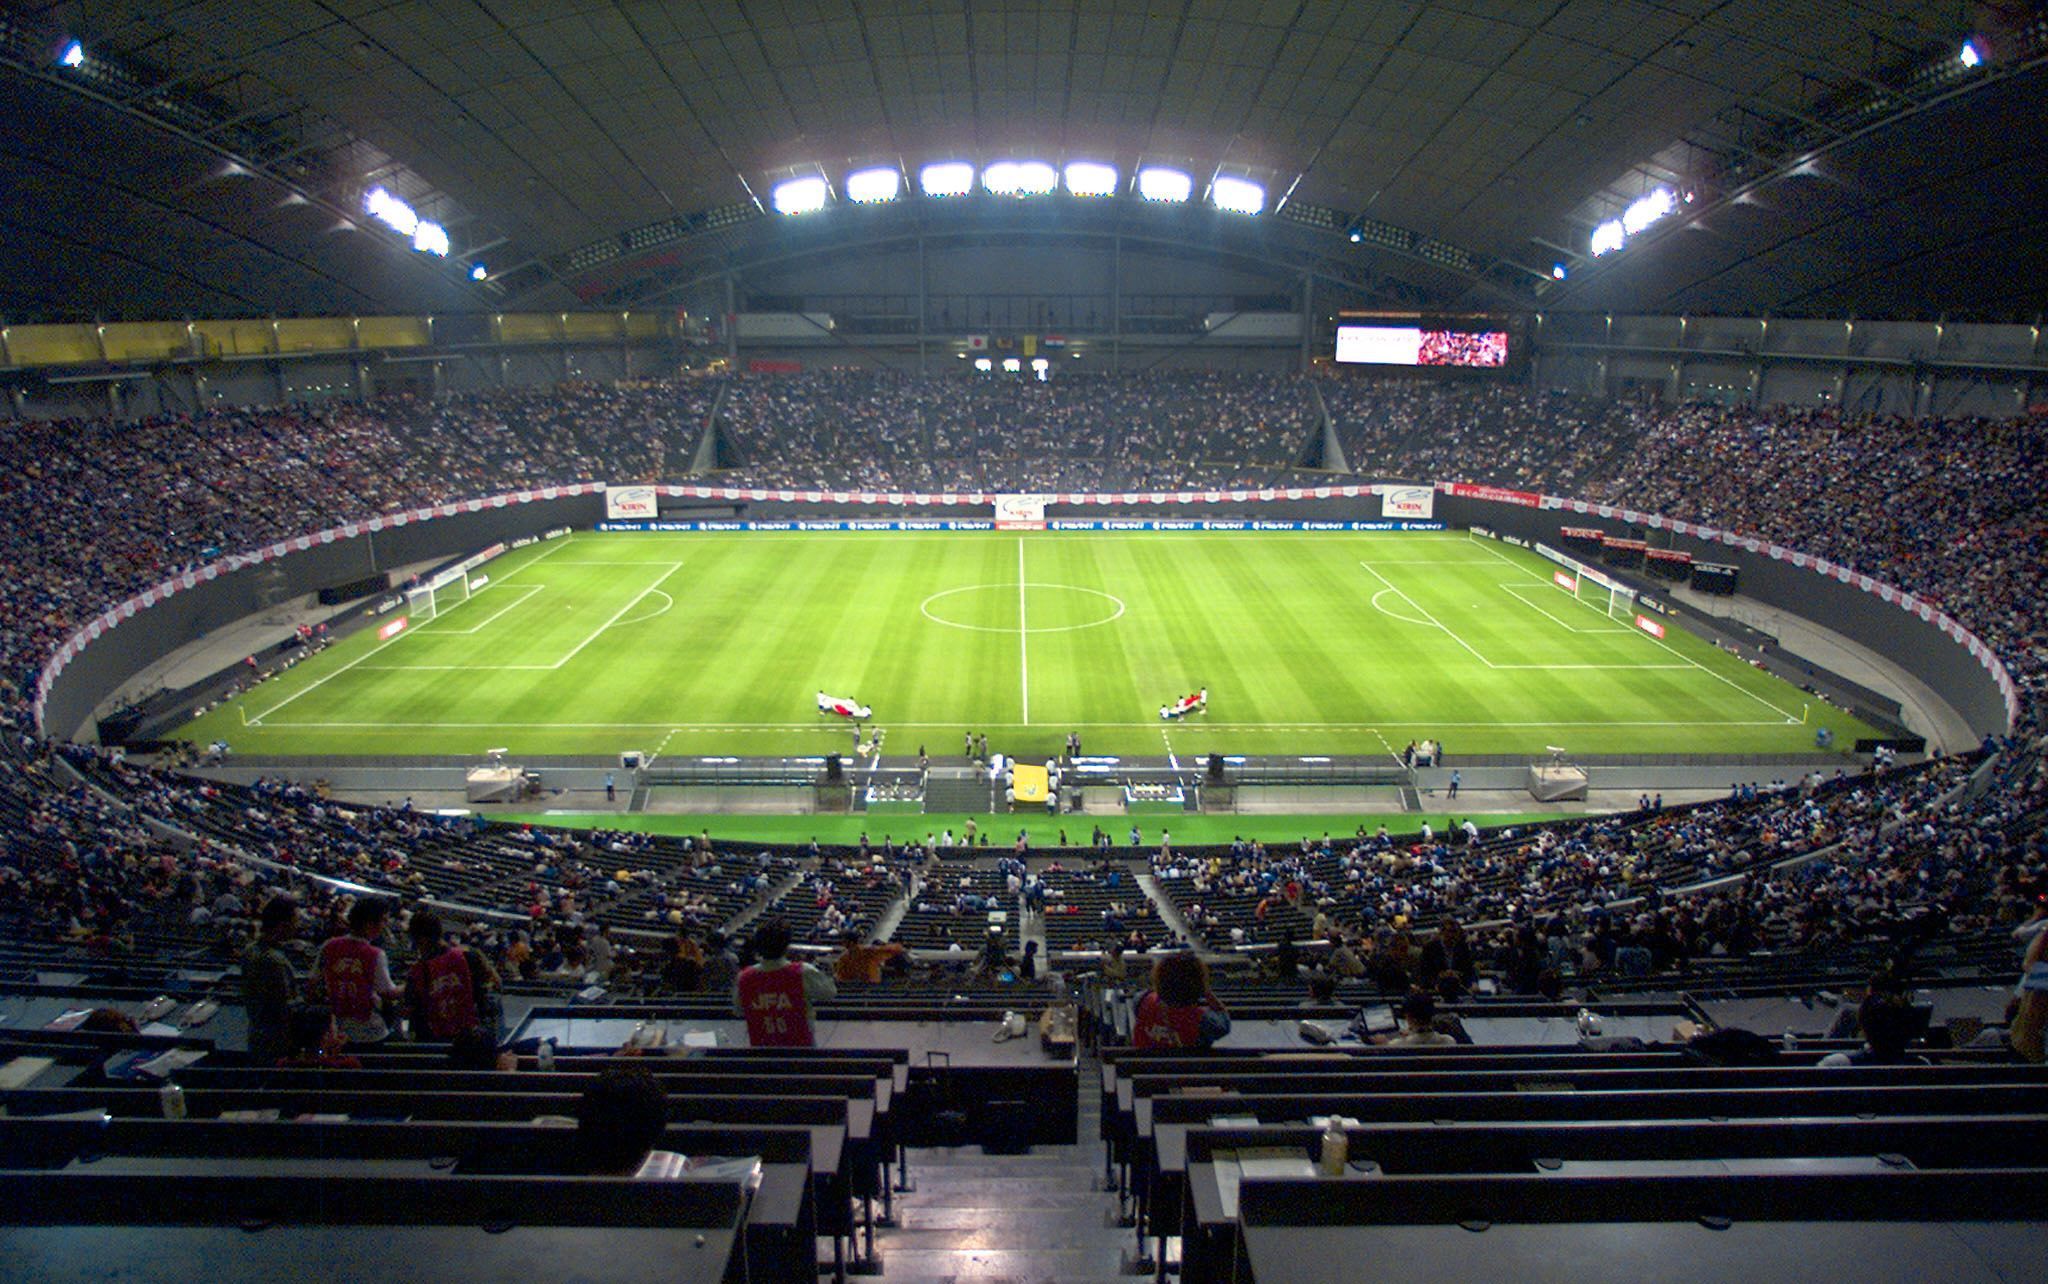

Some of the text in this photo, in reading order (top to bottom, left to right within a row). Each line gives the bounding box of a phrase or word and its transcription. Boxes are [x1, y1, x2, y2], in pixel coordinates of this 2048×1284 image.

[621, 503, 647, 511] KIRIN
[1396, 503, 1422, 511] KIRIN
[751, 992, 793, 1011] JFA
